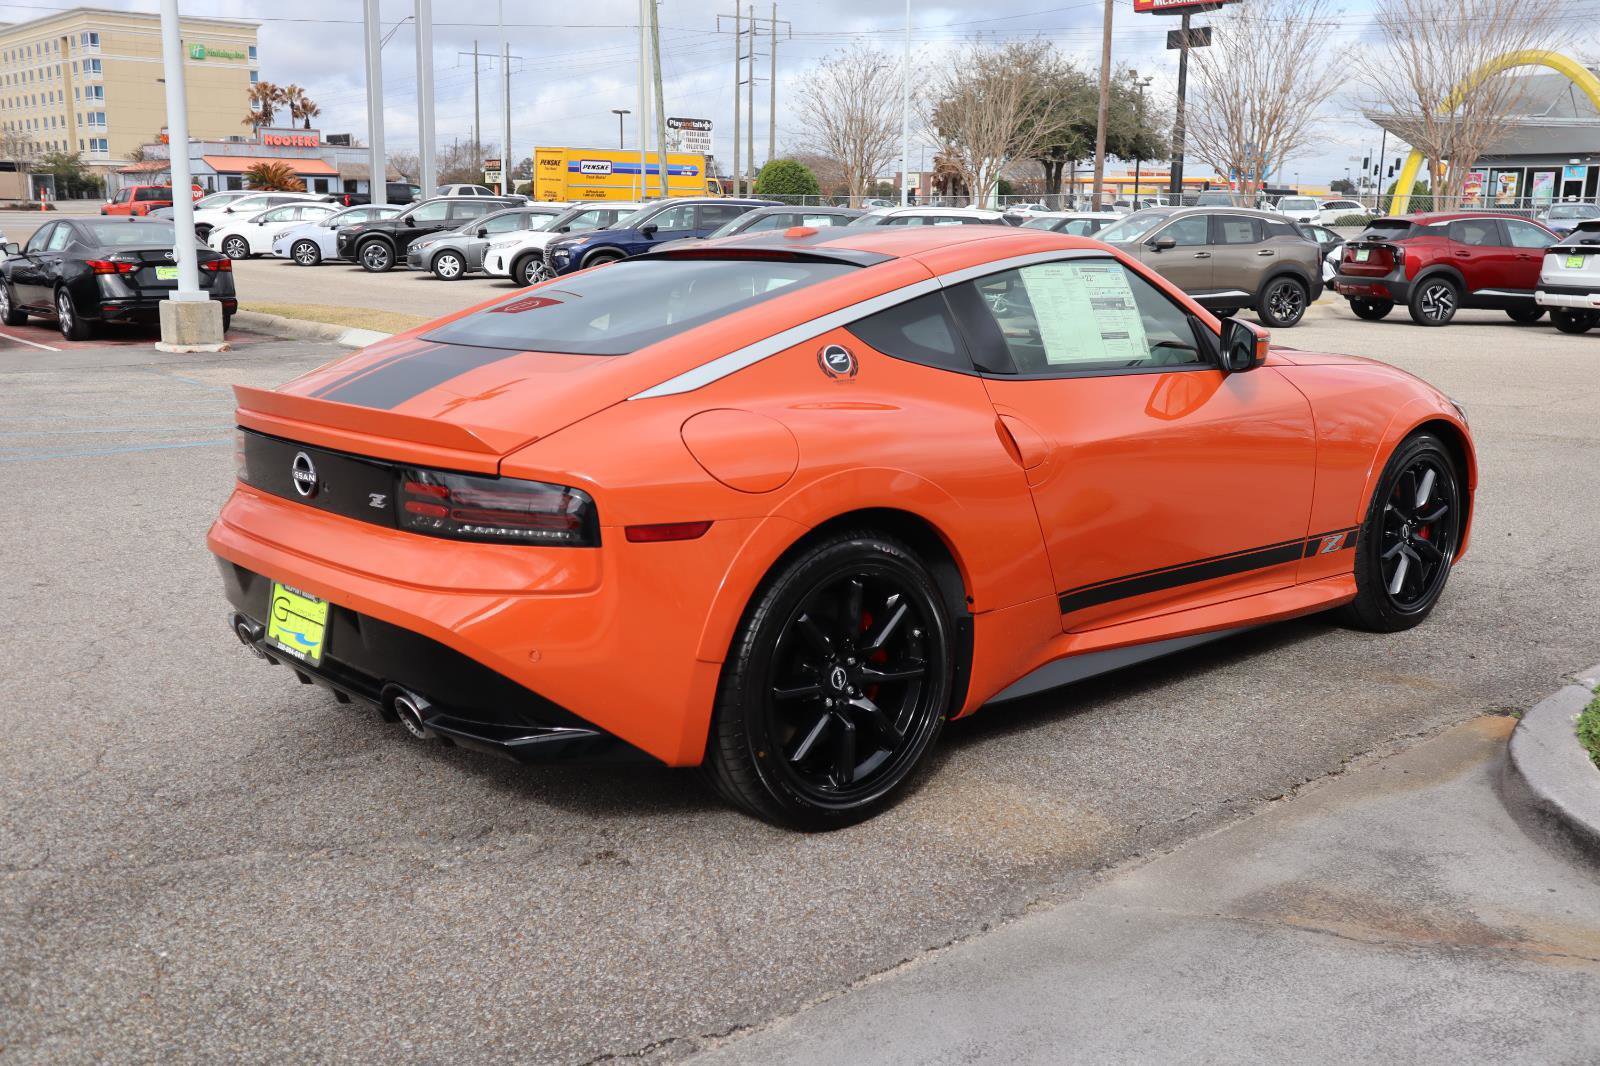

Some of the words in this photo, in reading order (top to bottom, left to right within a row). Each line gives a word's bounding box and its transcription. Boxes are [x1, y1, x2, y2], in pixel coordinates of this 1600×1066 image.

[264, 134, 320, 147] HOOTERS
[540, 159, 561, 167] PENSKE
[368, 492, 387, 508] Z
[1320, 534, 1344, 554] Z
